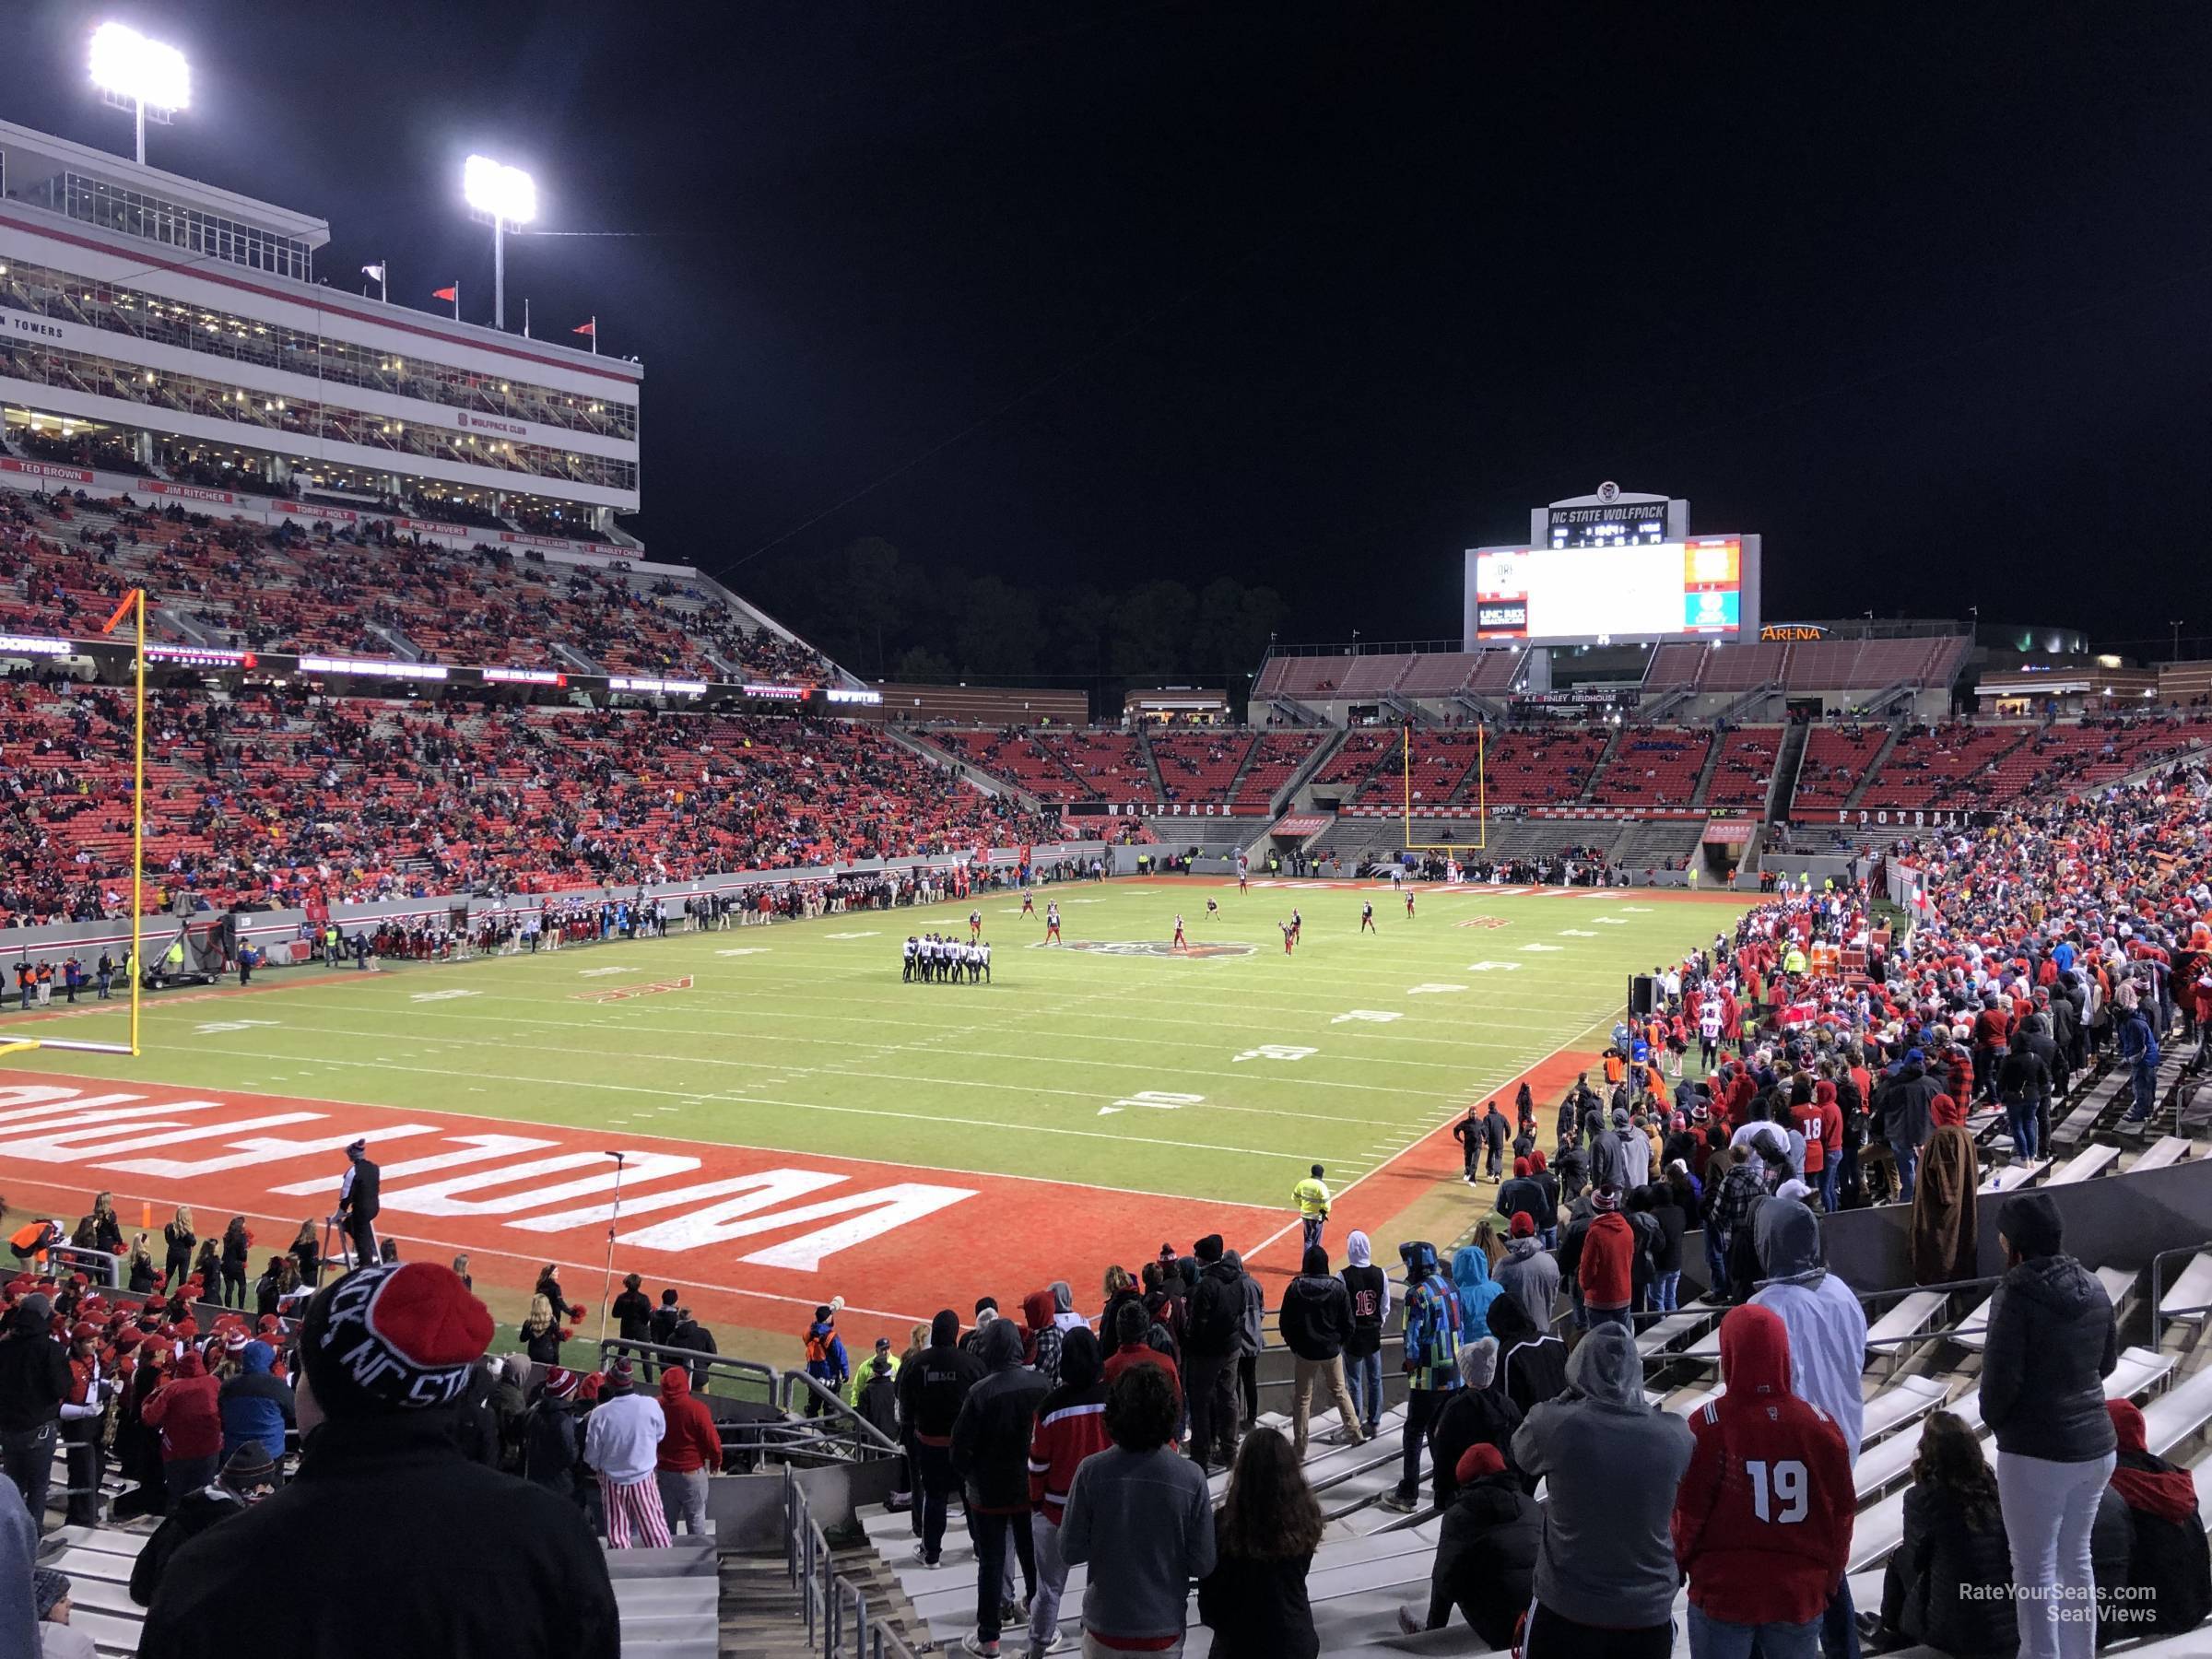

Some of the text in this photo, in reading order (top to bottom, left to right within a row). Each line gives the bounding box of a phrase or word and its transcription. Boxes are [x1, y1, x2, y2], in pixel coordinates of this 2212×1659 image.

[15, 319, 63, 338] TOWERS
[471, 417, 526, 435] WOLFPACK CLUB
[19, 463, 82, 481] TED BROWN
[164, 486, 225, 502] JIM RITCHER
[296, 505, 349, 520] TORRY HOLT
[1551, 505, 1665, 524] NC STATE WOLFPACK
[408, 521, 465, 535] PHILIP RIVERS
[595, 546, 621, 556] BRADLEY
[1761, 625, 1821, 641] ARENA
[1543, 694, 1568, 702] FINLEY
[1108, 805, 1231, 816] WOLFPACK
[1804, 1117, 1821, 1140] 18
[1356, 1289, 1377, 1316] 16
[1746, 1460, 1808, 1524] 19
